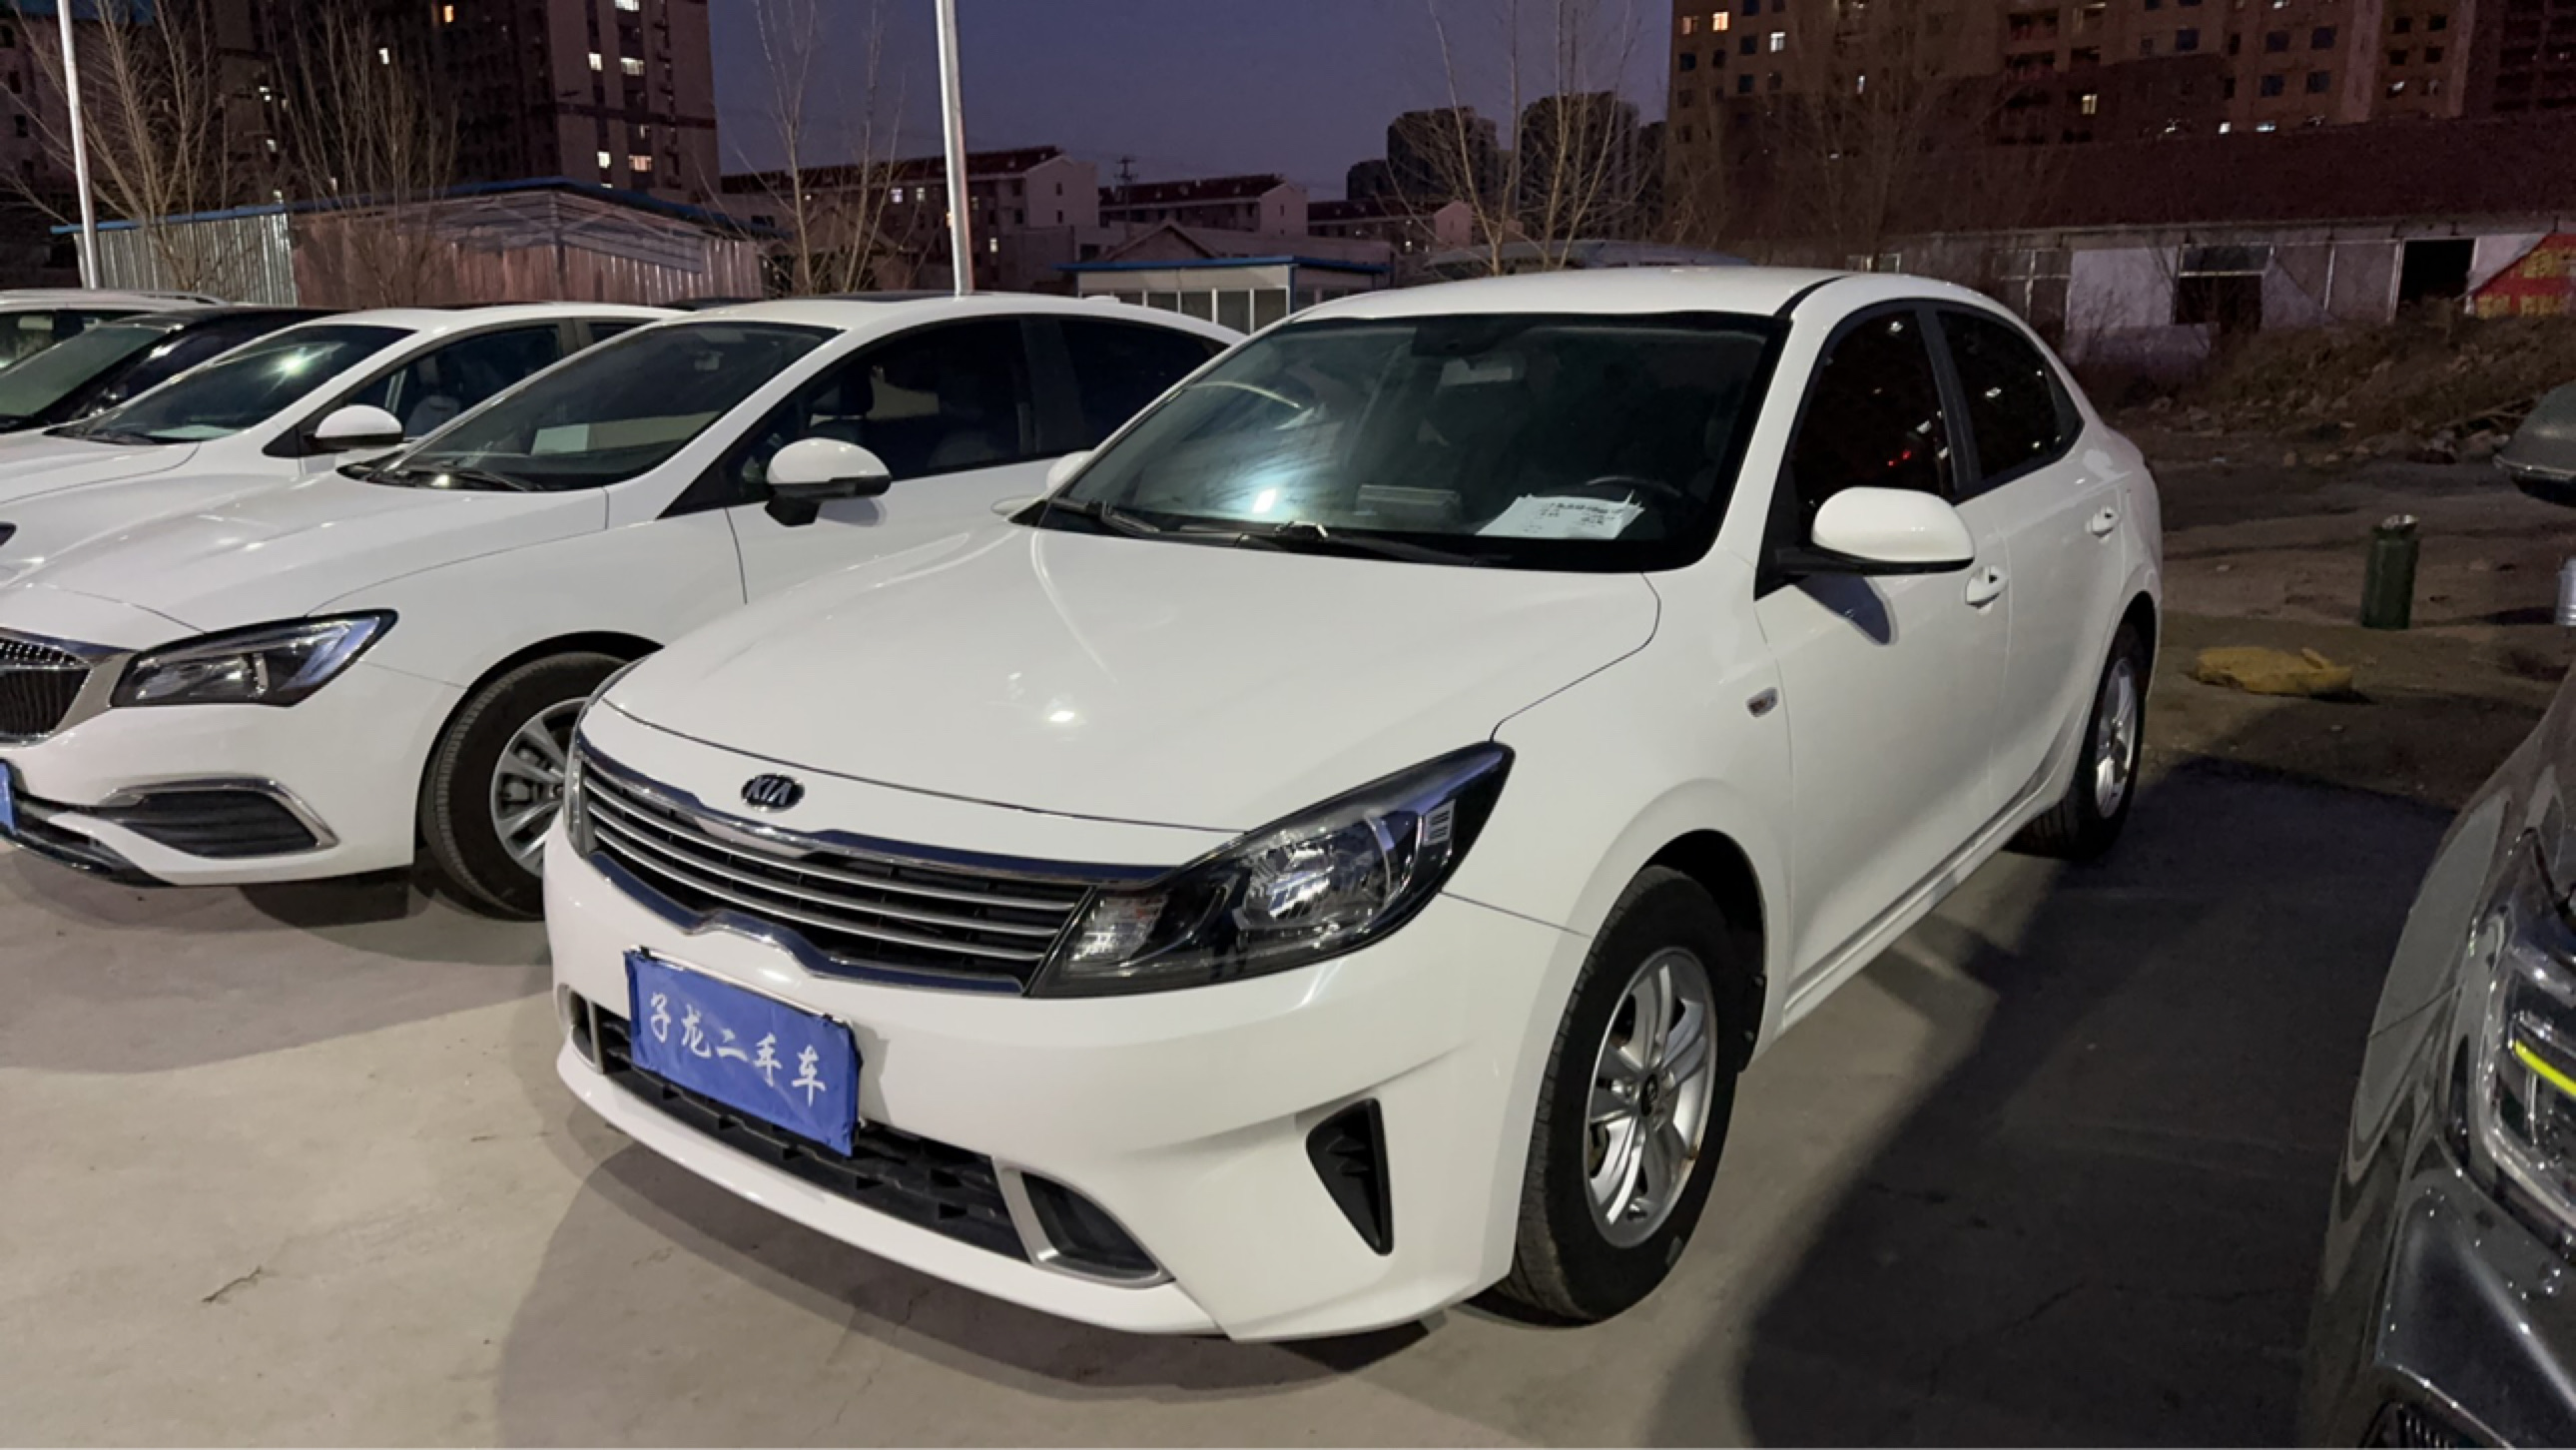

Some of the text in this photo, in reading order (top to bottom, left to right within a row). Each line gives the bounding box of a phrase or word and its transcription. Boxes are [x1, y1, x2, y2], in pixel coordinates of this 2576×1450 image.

[745, 776, 793, 806] KIA
[649, 992, 827, 1107] 子龙二手车
